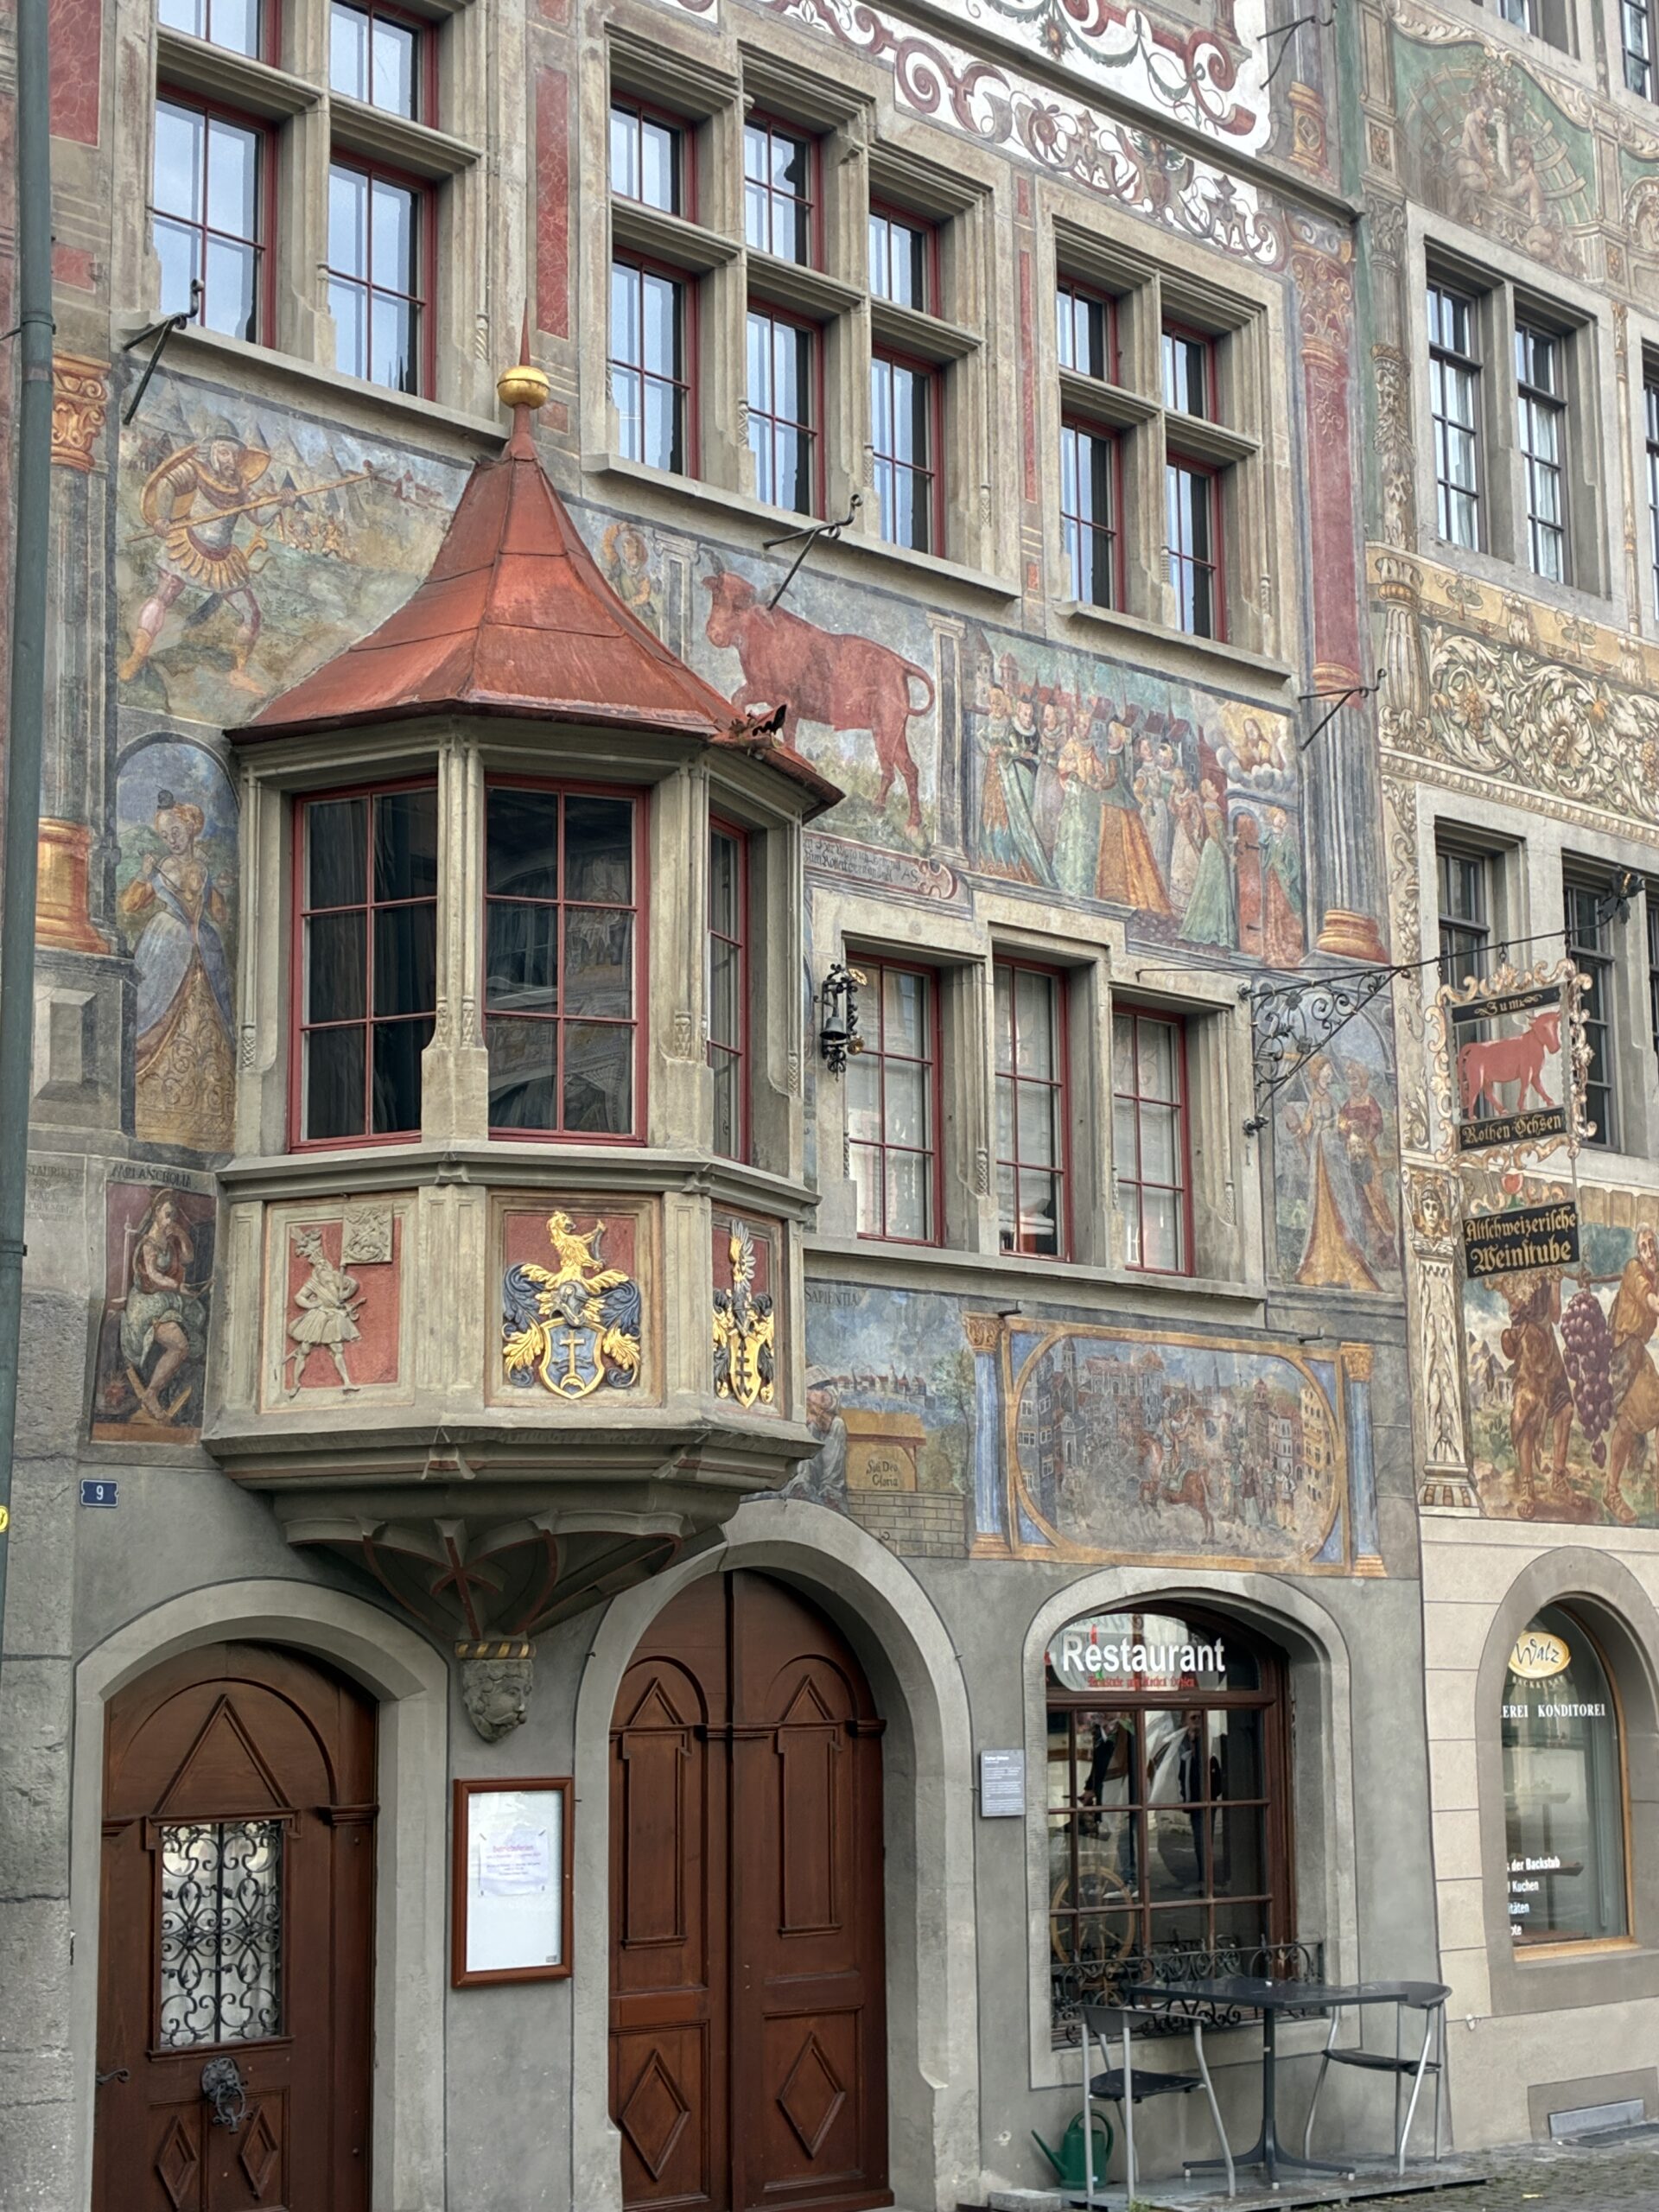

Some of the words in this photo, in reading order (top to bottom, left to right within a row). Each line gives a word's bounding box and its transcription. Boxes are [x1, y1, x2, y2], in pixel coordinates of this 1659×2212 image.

[1486, 998, 1520, 1016] Zum
[1462, 1123, 1510, 1144] Rothen
[1513, 1113, 1561, 1137] Ochsen
[882, 1460, 899, 1472] Deo
[96, 1484, 104, 1501] 9
[1063, 1635, 1226, 1673] Restaurant
[1516, 1638, 1560, 1666] Walz
[1500, 1704, 1529, 1719] EREI
[1537, 1703, 1605, 1718] KONDITOREI
[1511, 1859, 1524, 1872] der
[1525, 1855, 1560, 1871] Backstub
[1512, 1878, 1539, 1893] Kuchen
